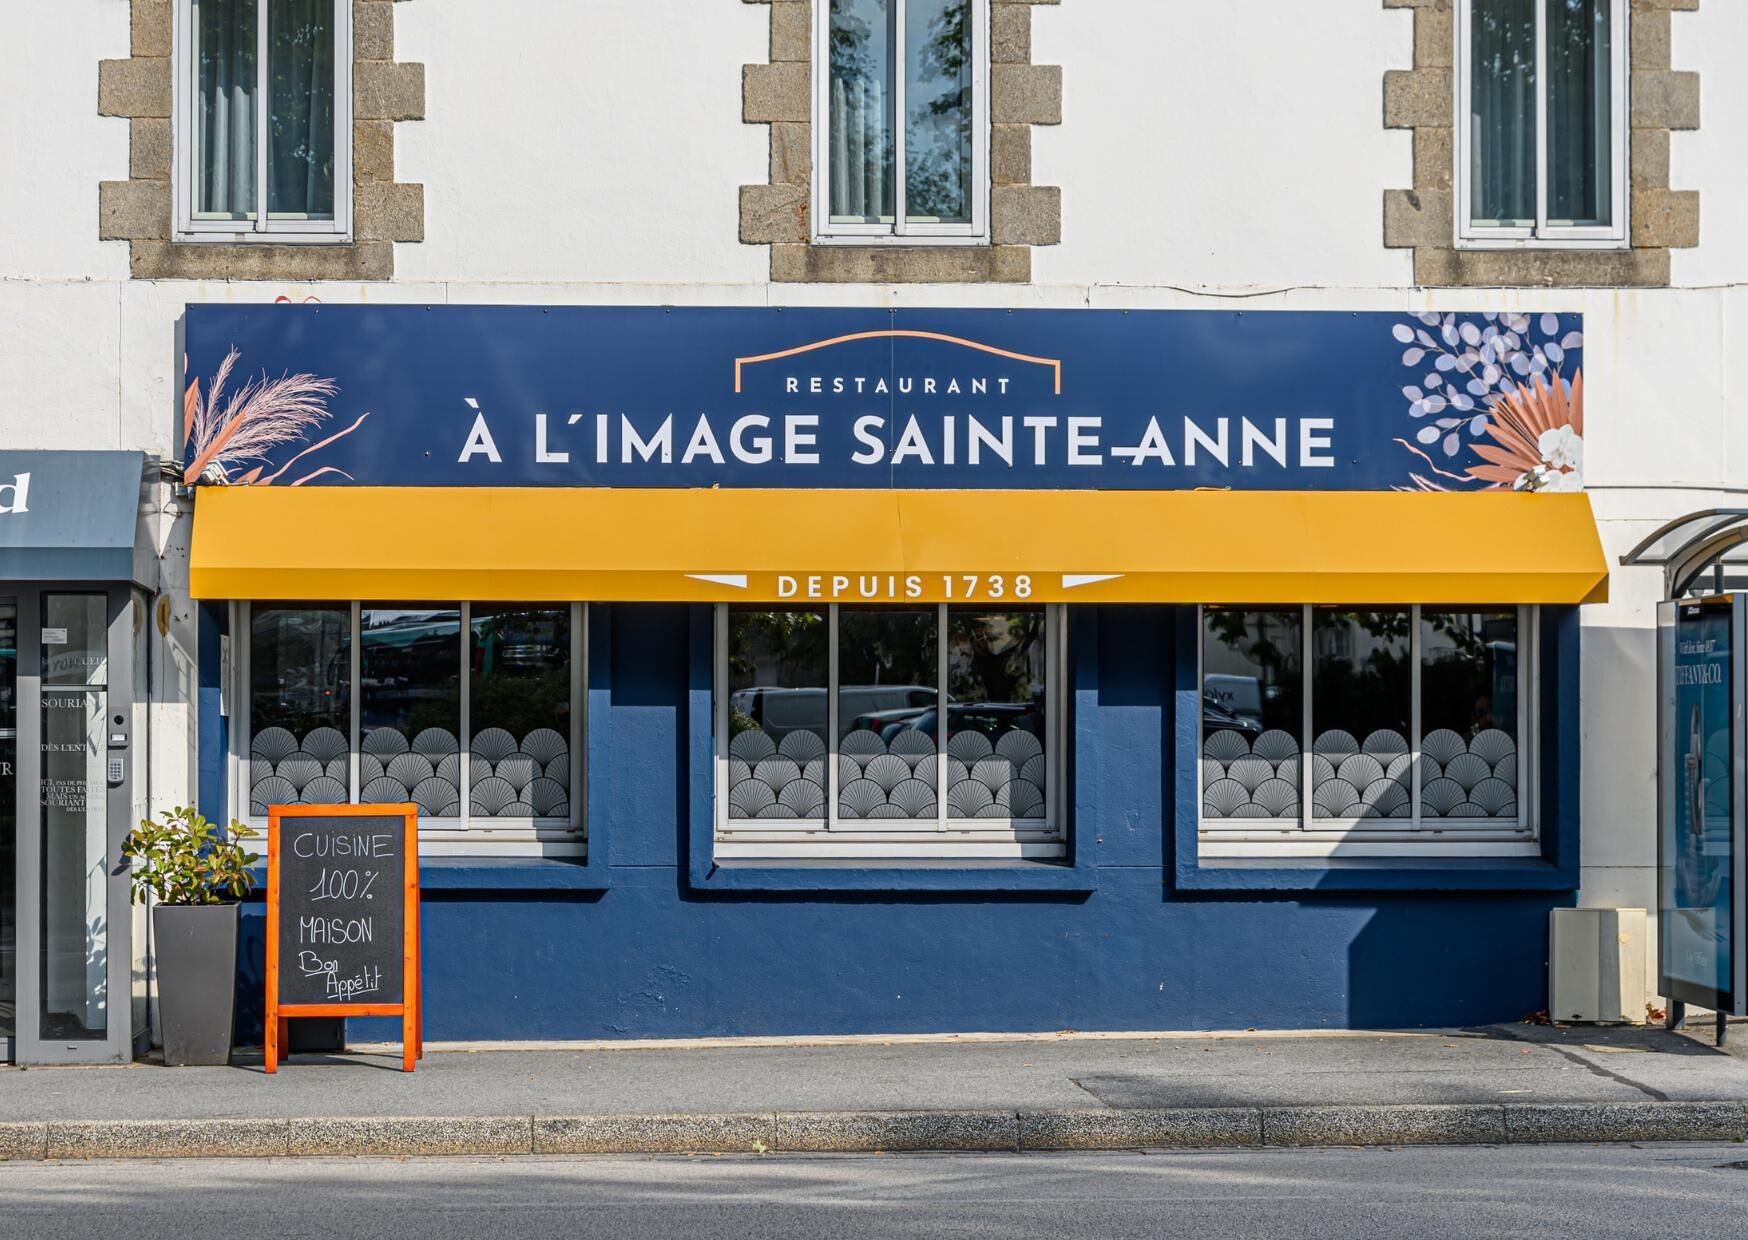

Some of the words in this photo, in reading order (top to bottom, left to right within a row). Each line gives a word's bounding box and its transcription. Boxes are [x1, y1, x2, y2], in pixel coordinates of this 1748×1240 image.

[786, 377, 1009, 394] RESTAURANT
[457, 397, 502, 464] À
[535, 413, 820, 465] L'IMAGE
[851, 413, 1335, 468] SAINTE-ANNE
[778, 575, 922, 598] DEPUIS
[943, 575, 1032, 599] 1738
[41, 698, 94, 709] SOURIA
[309, 867, 380, 902] 100%
[298, 950, 339, 976] Bon
